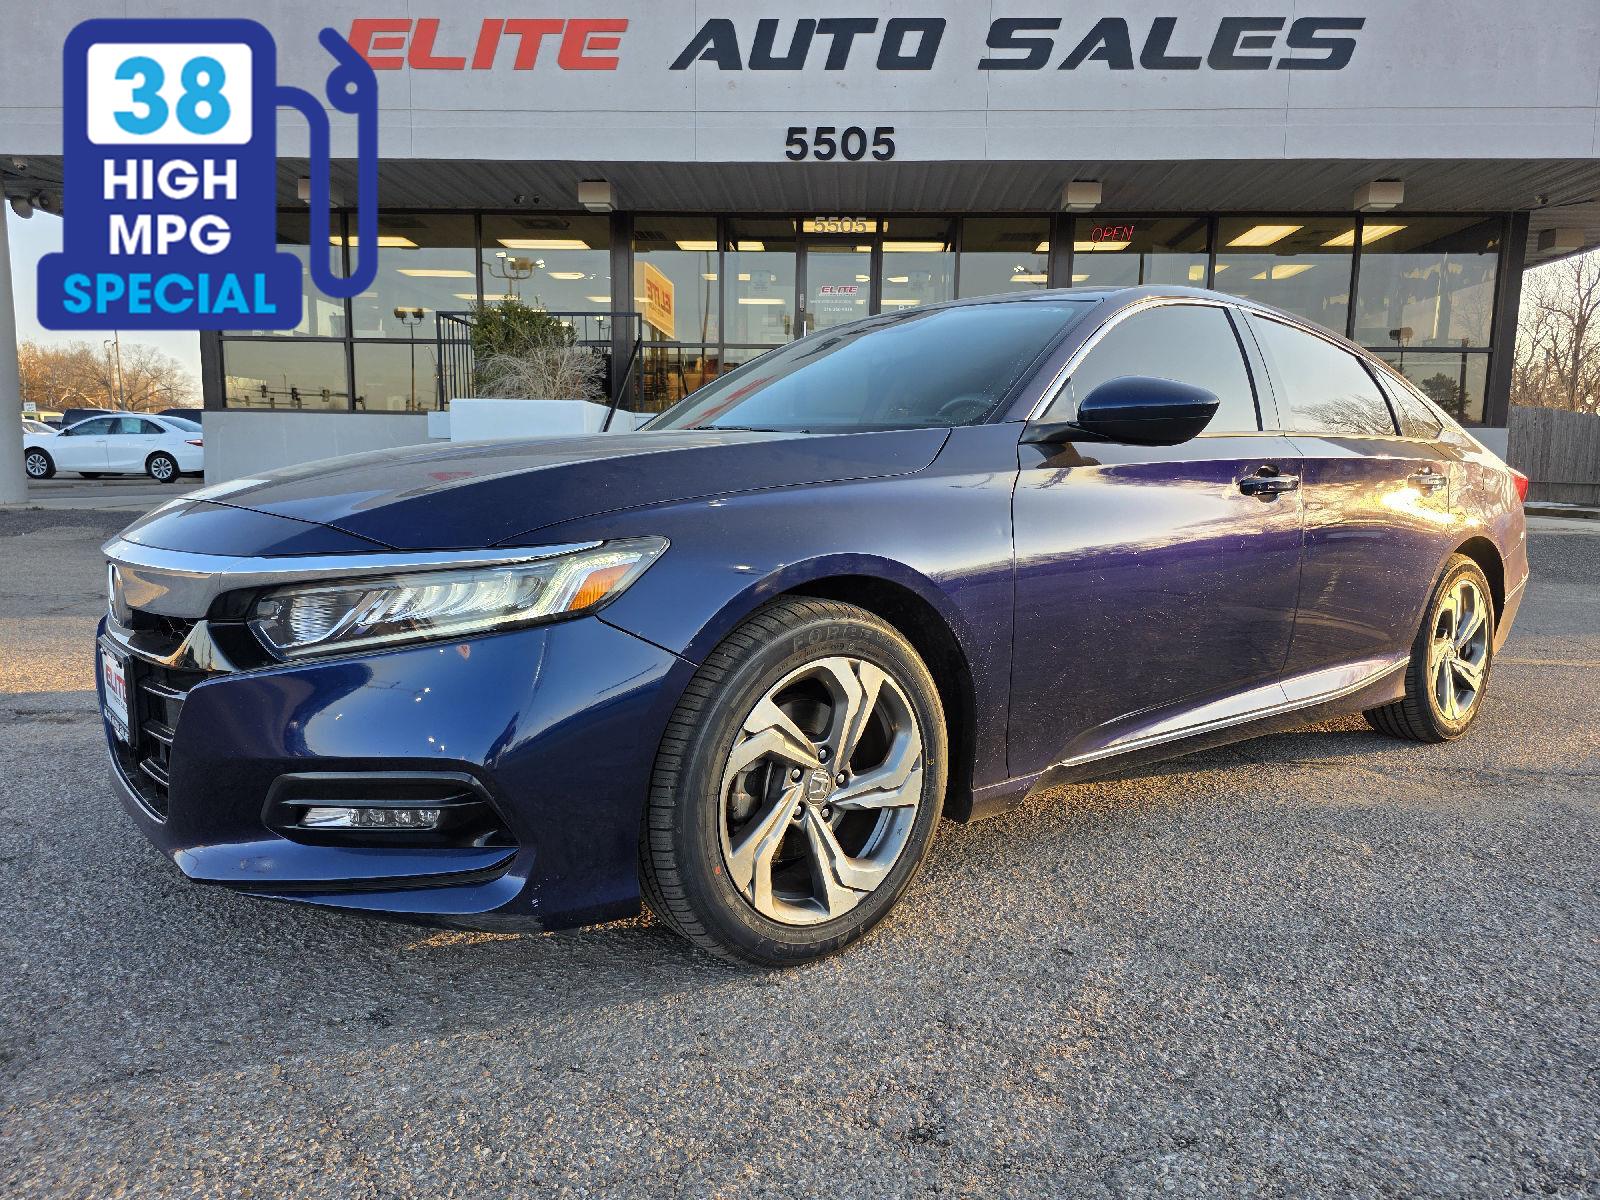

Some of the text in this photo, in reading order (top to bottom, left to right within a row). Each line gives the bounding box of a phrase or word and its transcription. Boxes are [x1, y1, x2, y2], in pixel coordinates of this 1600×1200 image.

[345, 17, 1366, 71] ELITE AUTO SALES
[785, 126, 896, 161] 5505
[814, 216, 867, 234] 5505
[1091, 225, 1135, 243] OPEN
[820, 286, 858, 295] ELITE
[106, 664, 128, 704] ELIT
